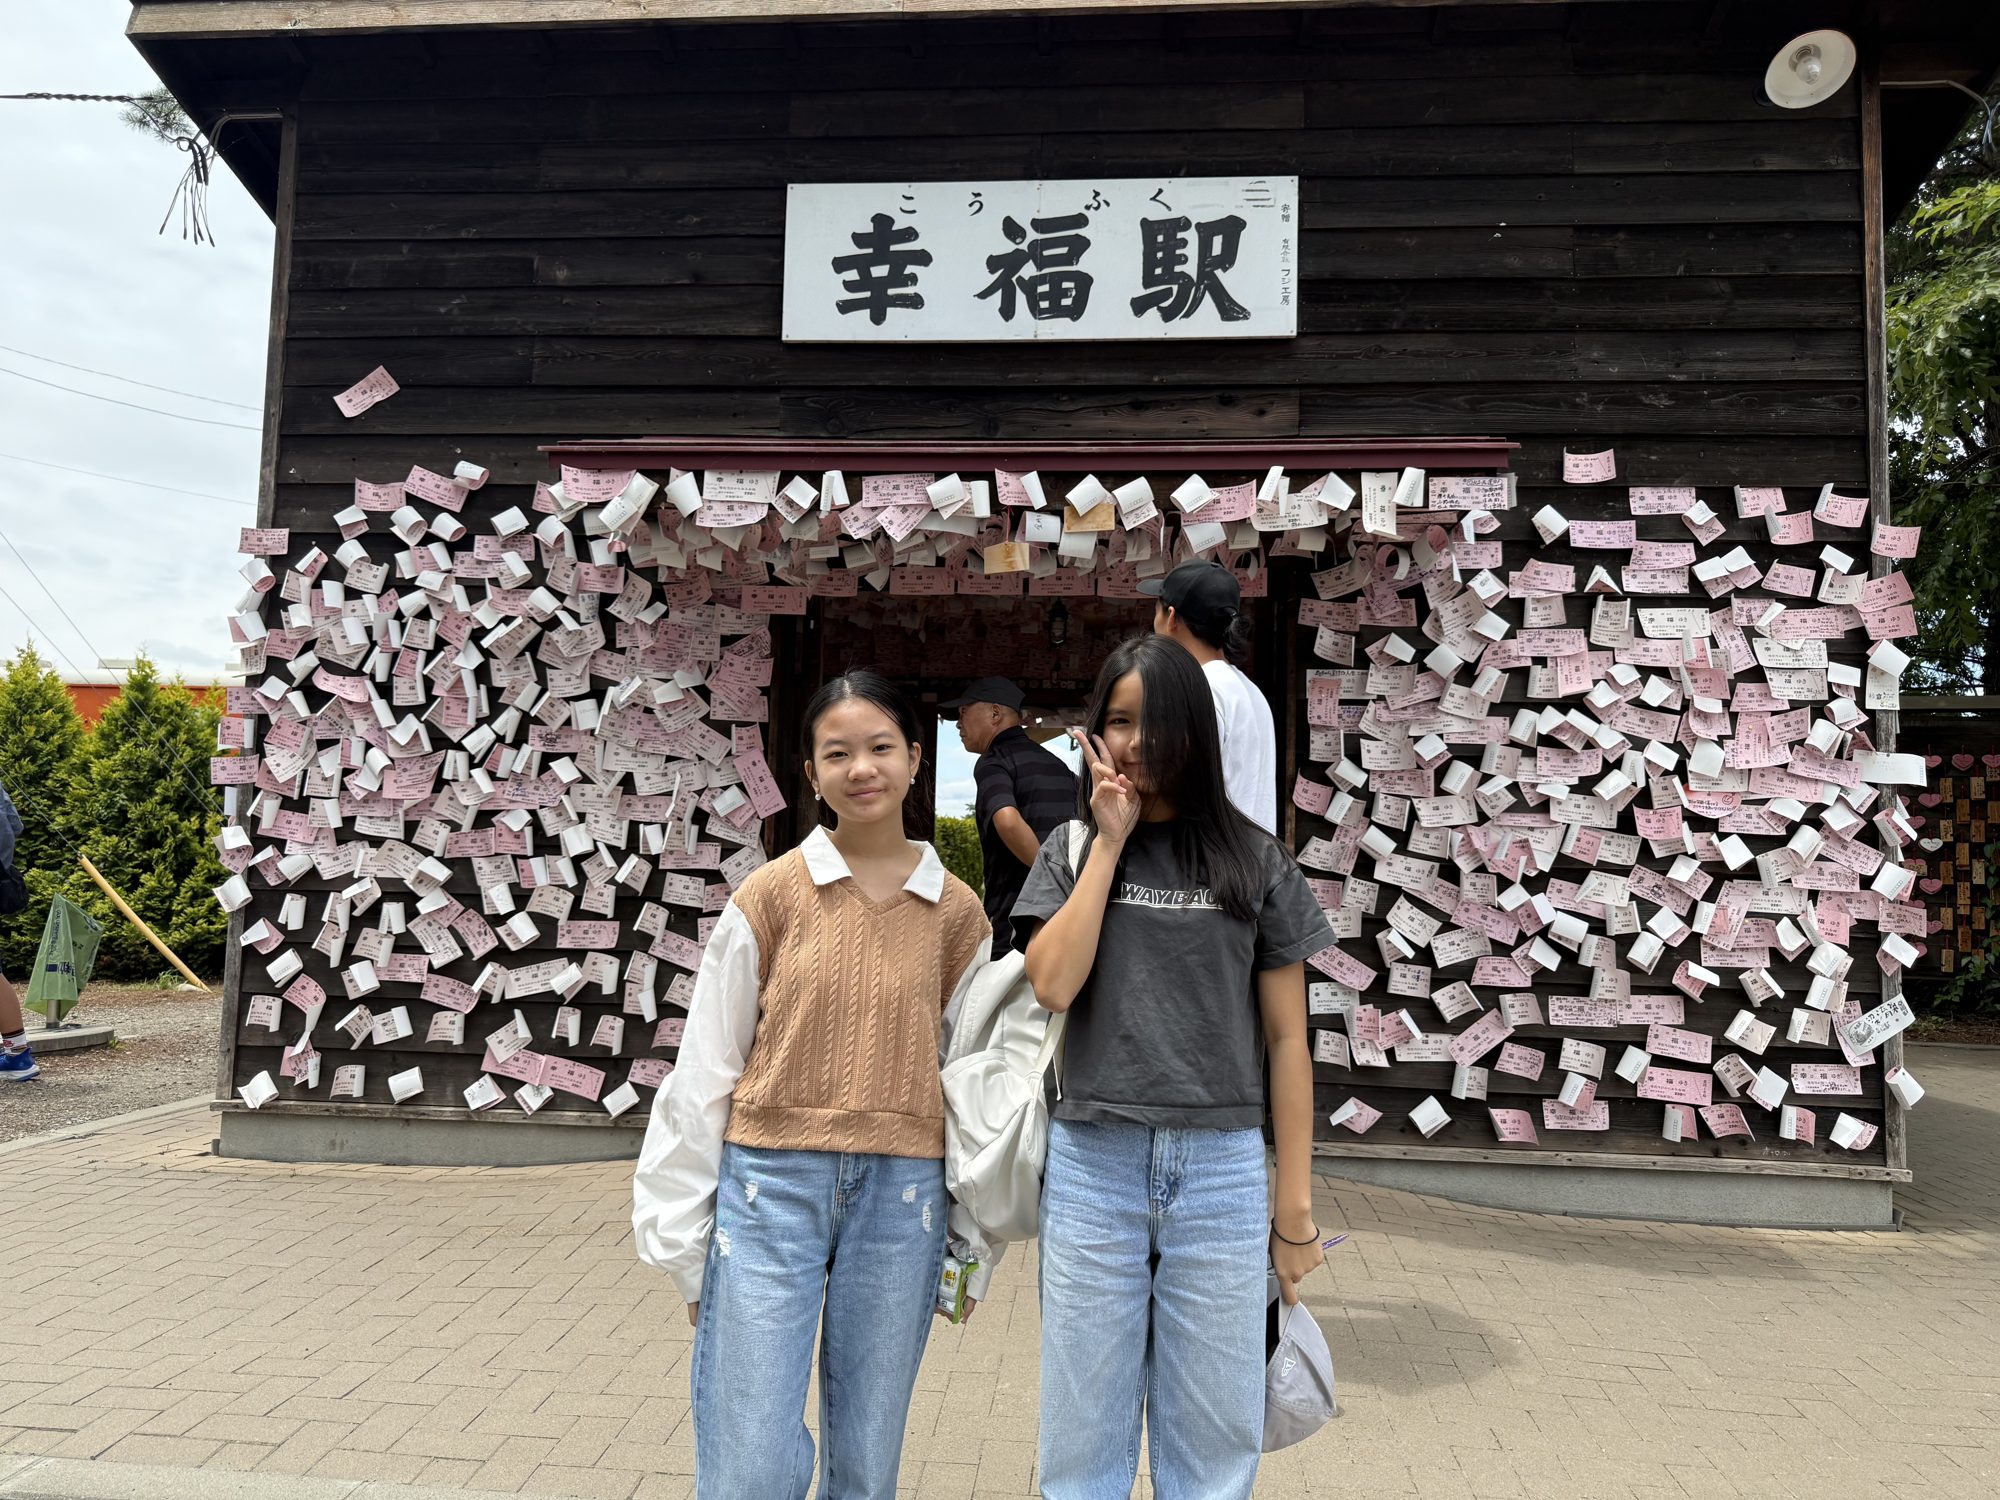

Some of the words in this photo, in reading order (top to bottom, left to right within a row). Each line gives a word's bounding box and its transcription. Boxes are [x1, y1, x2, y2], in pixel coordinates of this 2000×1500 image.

[900, 188, 1172, 216] こうふく
[831, 212, 1252, 326] 幸福駅
